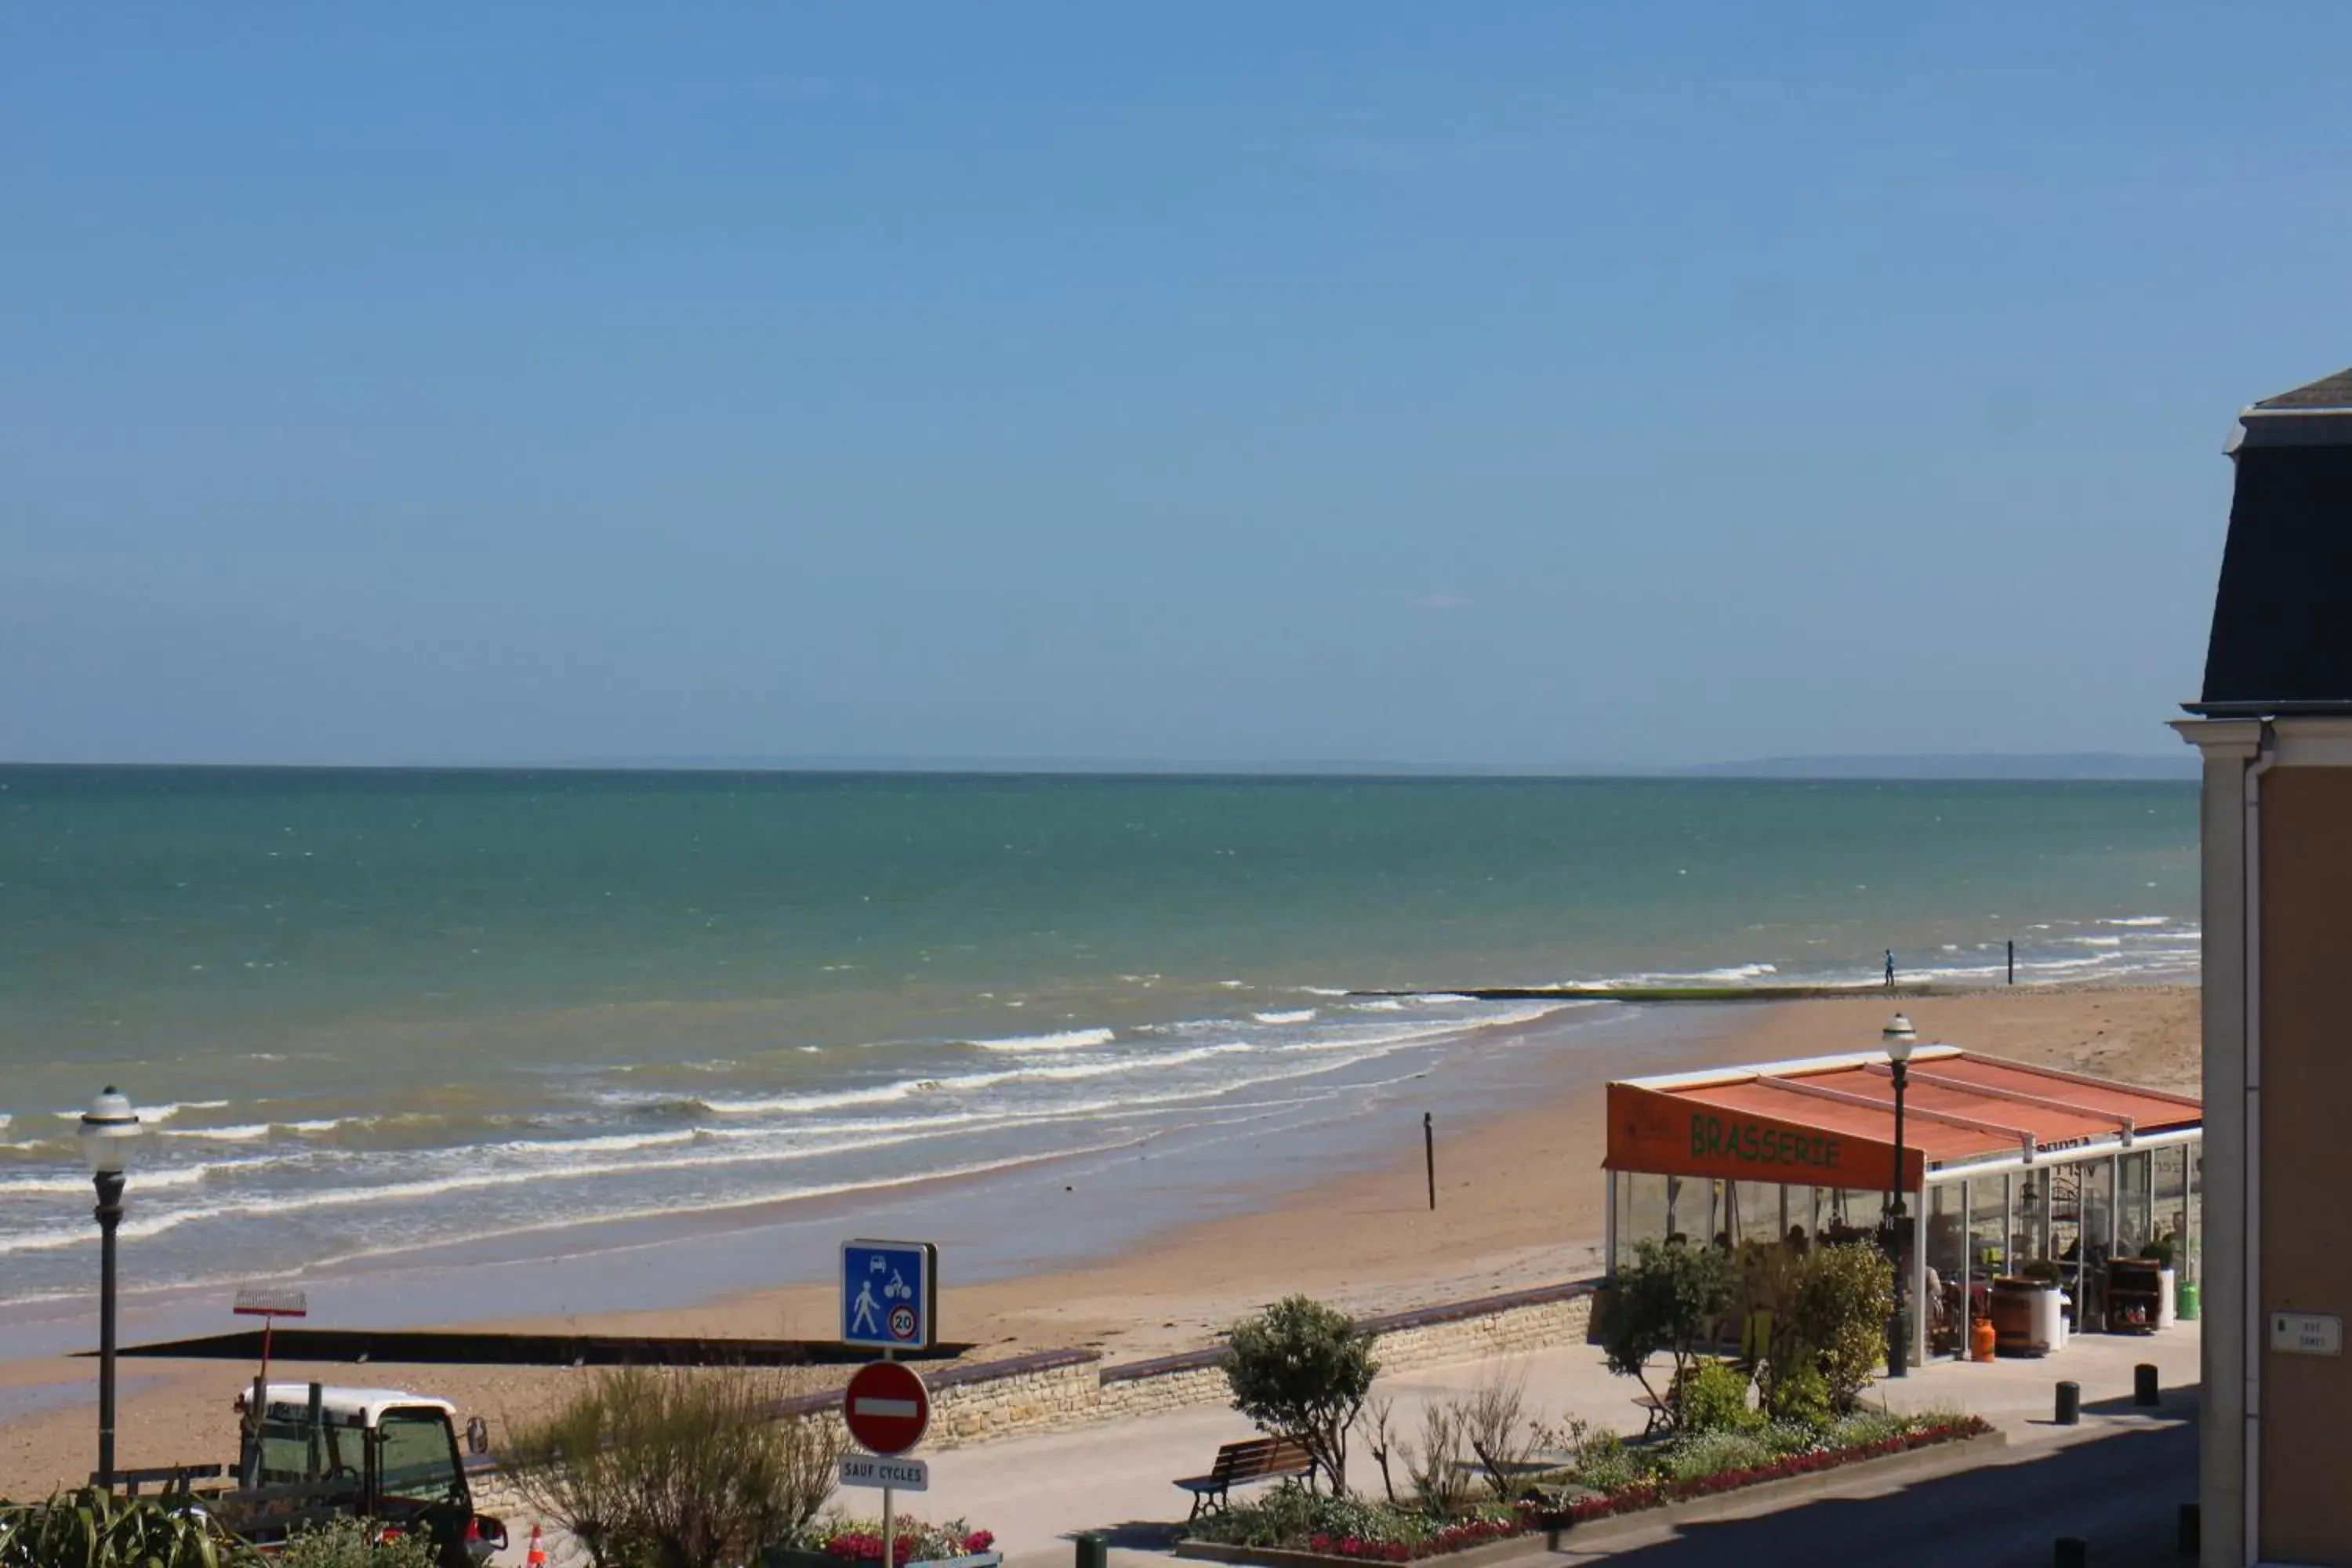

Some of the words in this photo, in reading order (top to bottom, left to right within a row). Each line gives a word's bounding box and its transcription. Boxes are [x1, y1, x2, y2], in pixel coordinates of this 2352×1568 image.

[1692, 1113, 1842, 1167] BRASSERIE
[893, 1316, 912, 1330] 20
[844, 1462, 874, 1478] SAUF
[879, 1465, 921, 1483] CYCLES
